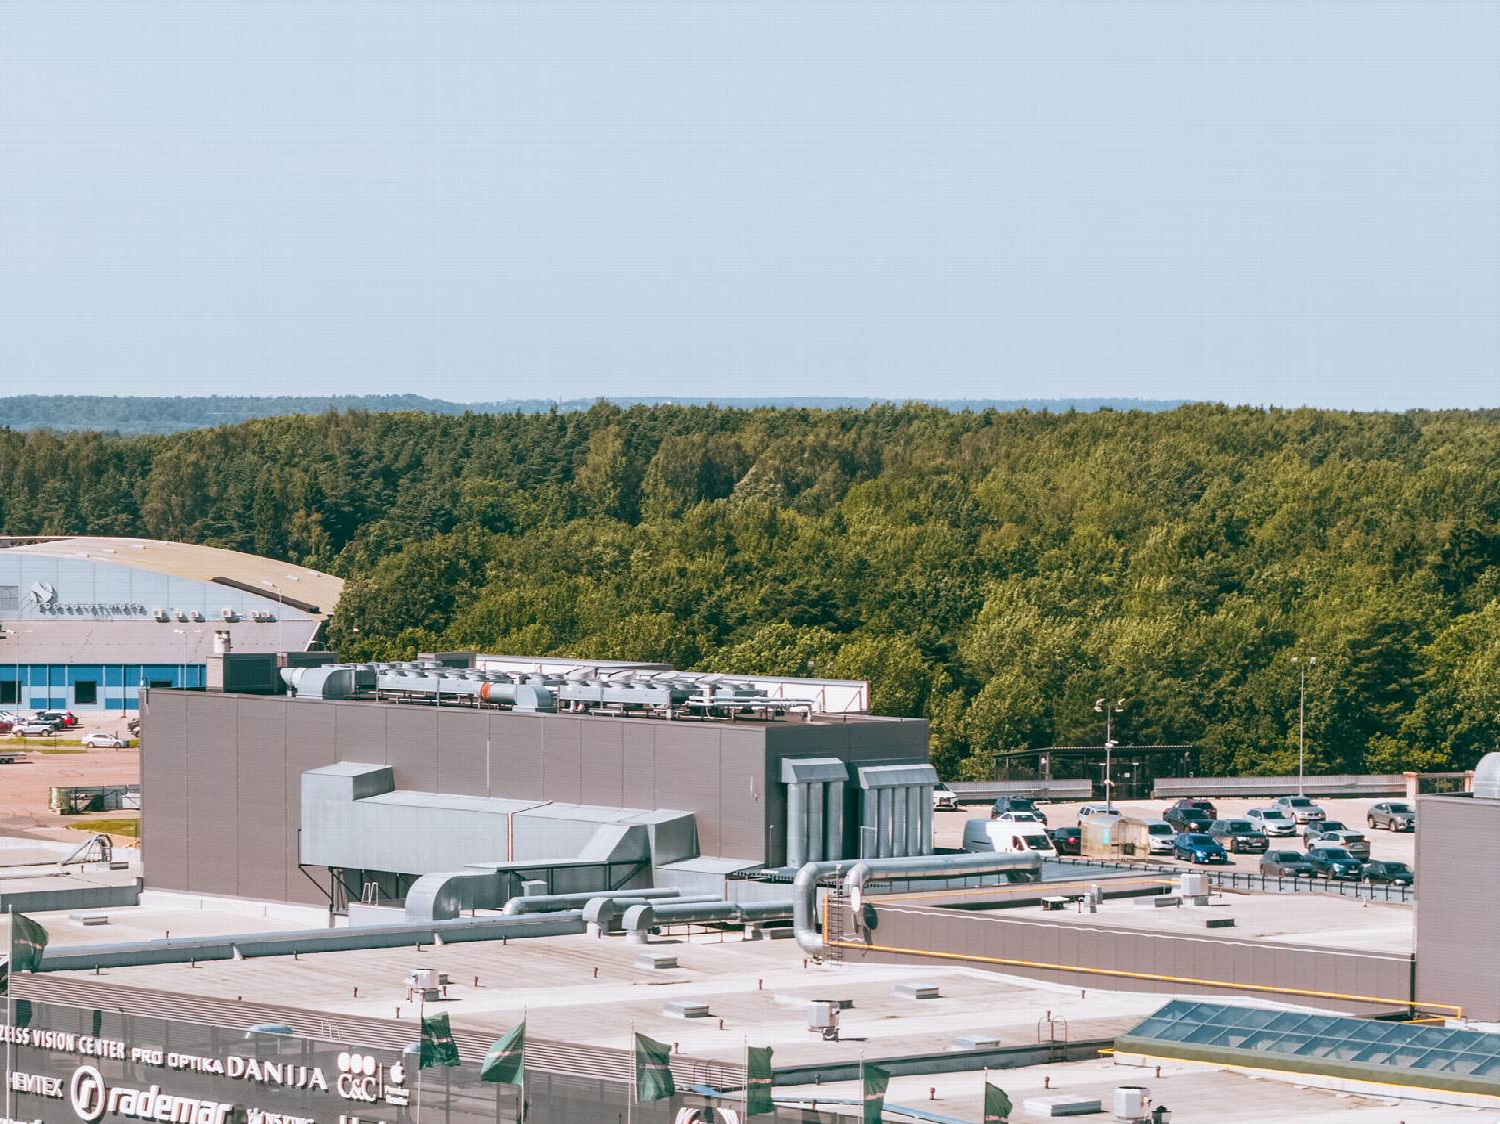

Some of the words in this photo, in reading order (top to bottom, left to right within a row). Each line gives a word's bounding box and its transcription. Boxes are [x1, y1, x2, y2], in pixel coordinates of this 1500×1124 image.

[32, 1029, 75, 1051] VISION
[78, 1037, 126, 1060] CENTER
[131, 1048, 164, 1065] PRO
[168, 1053, 224, 1075] OPTIKA
[226, 1055, 329, 1091] DANIJA
[337, 1073, 377, 1102] C&C
